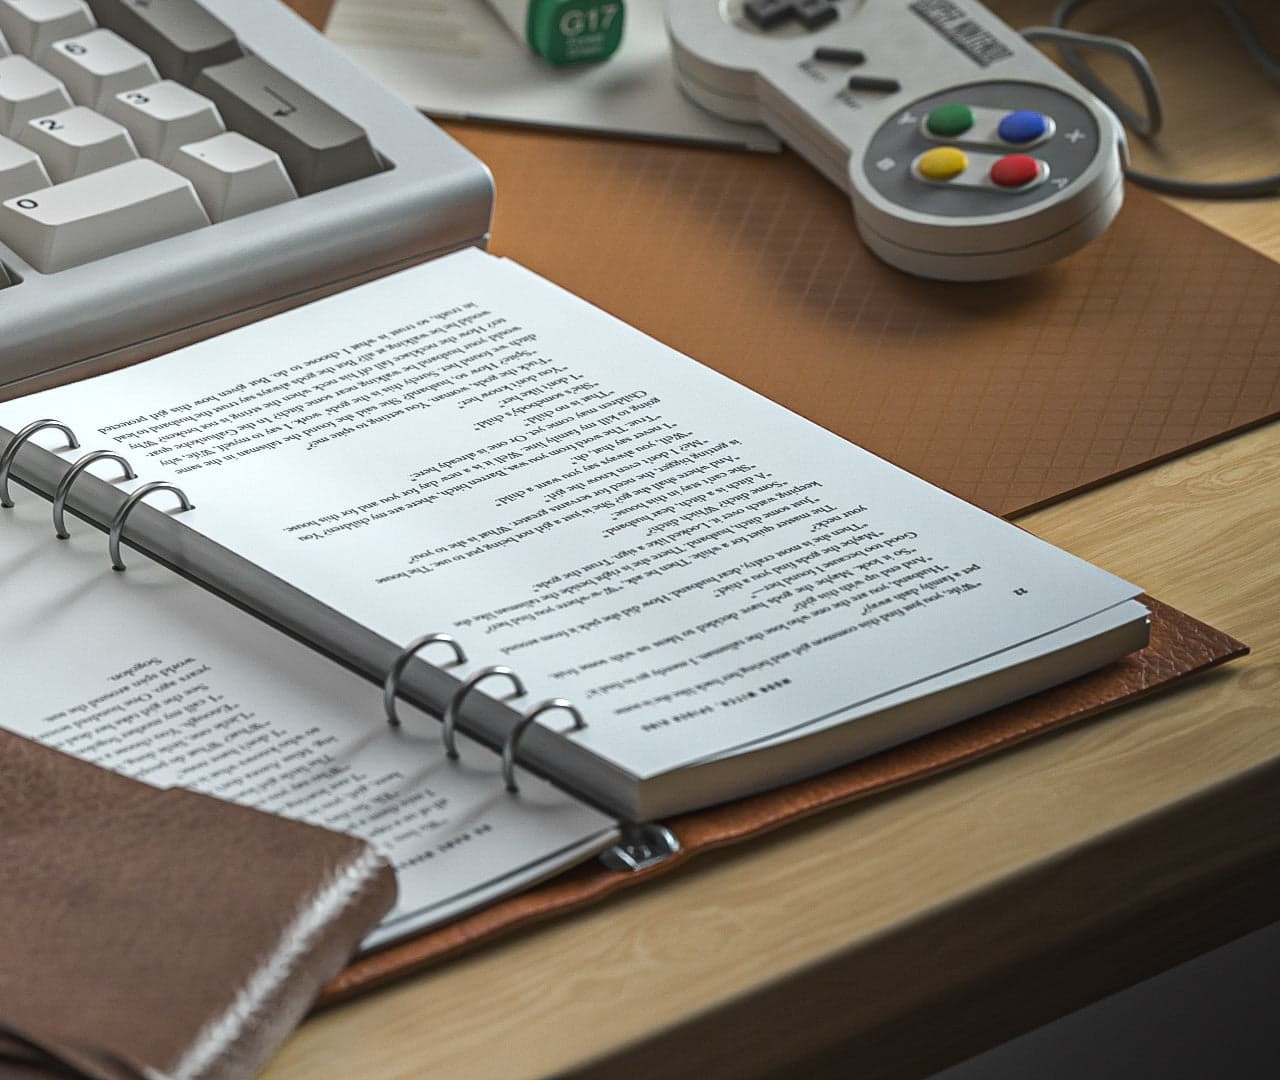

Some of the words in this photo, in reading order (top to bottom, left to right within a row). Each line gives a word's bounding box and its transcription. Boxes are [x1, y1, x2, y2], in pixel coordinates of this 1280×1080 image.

[559, 3, 618, 38] G17
[63, 41, 88, 58] 6
[125, 92, 150, 106] 3
[39, 118, 65, 132] 2
[502, 391, 566, 418] somebody’s
[596, 388, 649, 411] Children
[627, 395, 662, 412] going
[573, 405, 600, 420] may
[615, 407, 632, 417] to
[543, 414, 576, 430] come
[577, 420, 598, 432] my
[595, 412, 622, 427] kill
[523, 424, 548, 437] yet.
[543, 427, 582, 444] family
[600, 424, 630, 437] The
[485, 439, 509, 452] one
[506, 433, 529, 444] Or
[518, 439, 549, 452] line.
[572, 432, 605, 449] word
[474, 446, 491, 455] is
[546, 442, 579, 457] from
[435, 450, 478, 470] already
[480, 458, 497, 467] it
[491, 449, 525, 465] Well
[525, 450, 551, 465] you
[461, 466, 472, 474] a
[469, 462, 484, 471] is
[501, 460, 530, 472] was,
[438, 469, 464, 483] new
[465, 468, 510, 486] Barren
[399, 486, 422, 497] for
[416, 478, 440, 491] day
[434, 481, 474, 497] bitch,
[377, 491, 402, 505] you
[402, 493, 440, 510] where
[338, 506, 360, 517] for
[355, 499, 380, 514] and
[385, 504, 406, 516] are
[316, 512, 341, 524] this
[368, 510, 389, 521] my
[280, 518, 322, 533] house.
[321, 515, 371, 537] children?
[296, 530, 326, 543] You
[1010, 585, 1030, 597] 22
